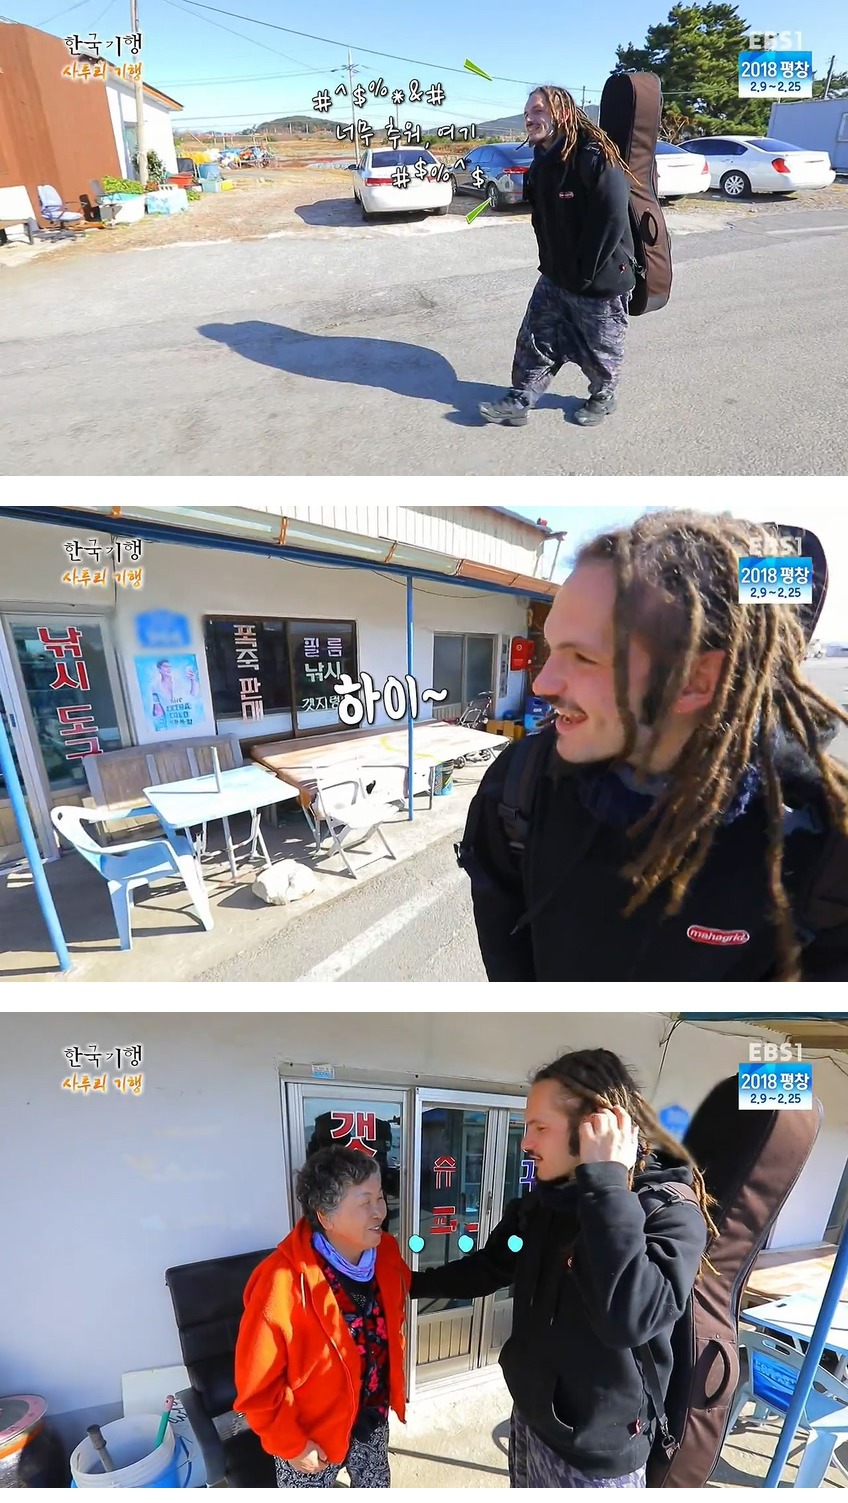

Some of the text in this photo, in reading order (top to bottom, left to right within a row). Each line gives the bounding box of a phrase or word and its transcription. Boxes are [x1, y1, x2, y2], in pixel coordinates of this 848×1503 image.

[37, 626, 103, 760] 낚시 도구
[233, 624, 264, 722] 폭죽 판매
[304, 661, 342, 683] 낚시
